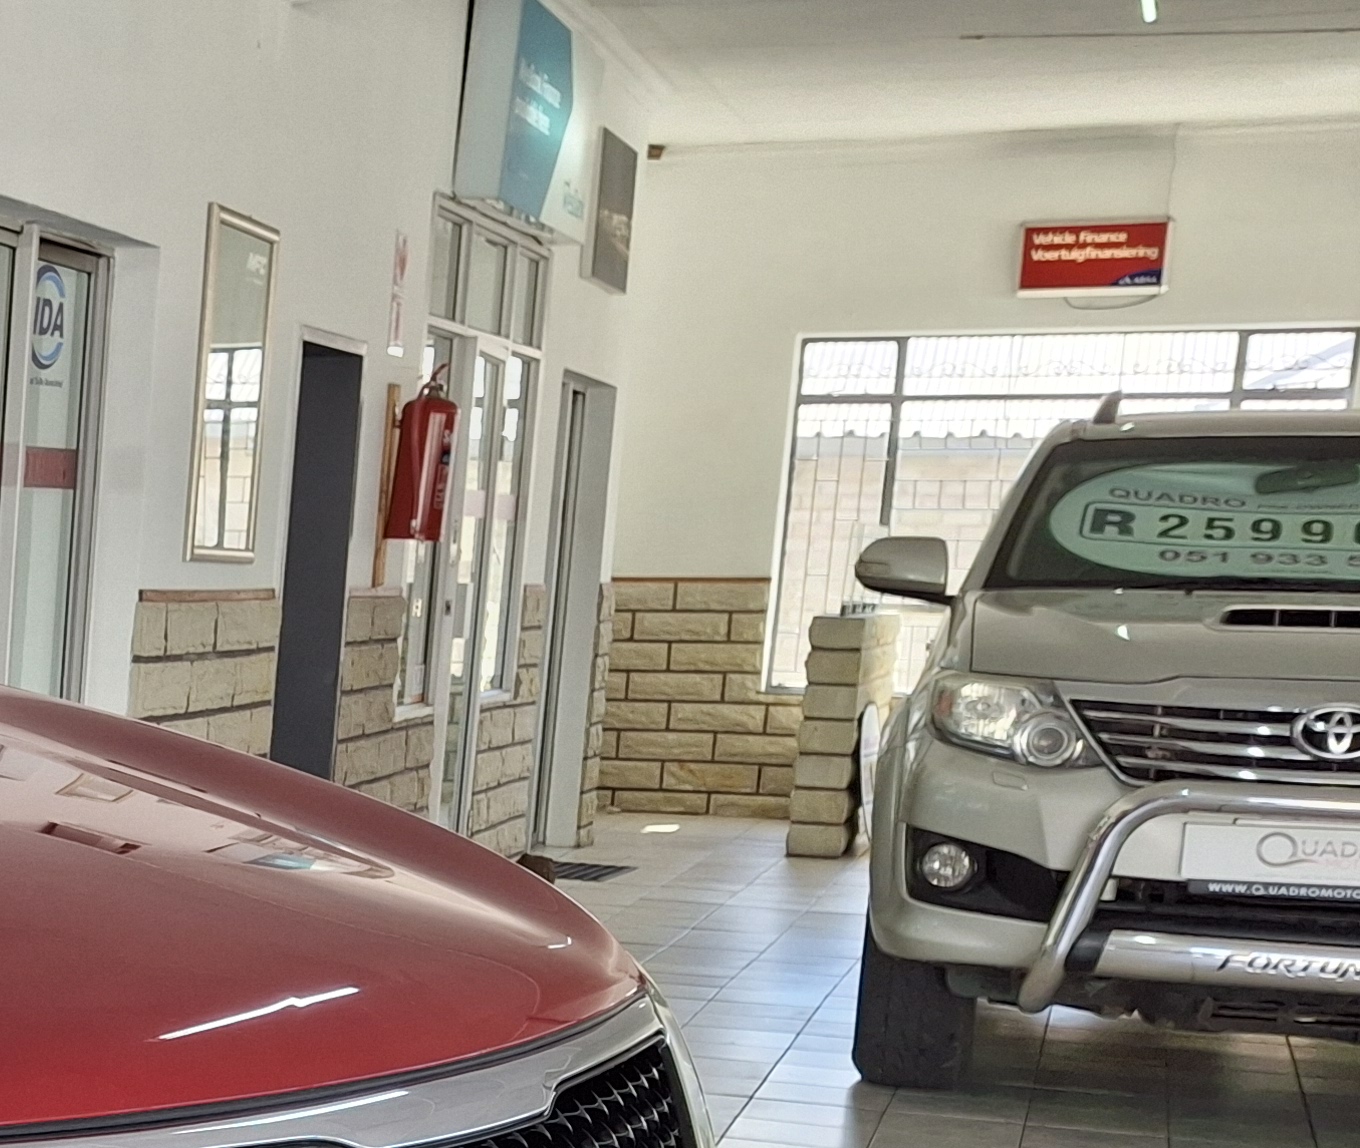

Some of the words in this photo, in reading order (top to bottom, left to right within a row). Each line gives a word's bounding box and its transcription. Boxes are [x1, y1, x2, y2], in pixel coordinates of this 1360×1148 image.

[1032, 231, 1077, 245] Vehicle
[1079, 229, 1129, 244] Finance
[1108, 487, 1247, 509] QUADRO
[1088, 507, 1137, 538] R
[1158, 549, 1230, 564] 051
